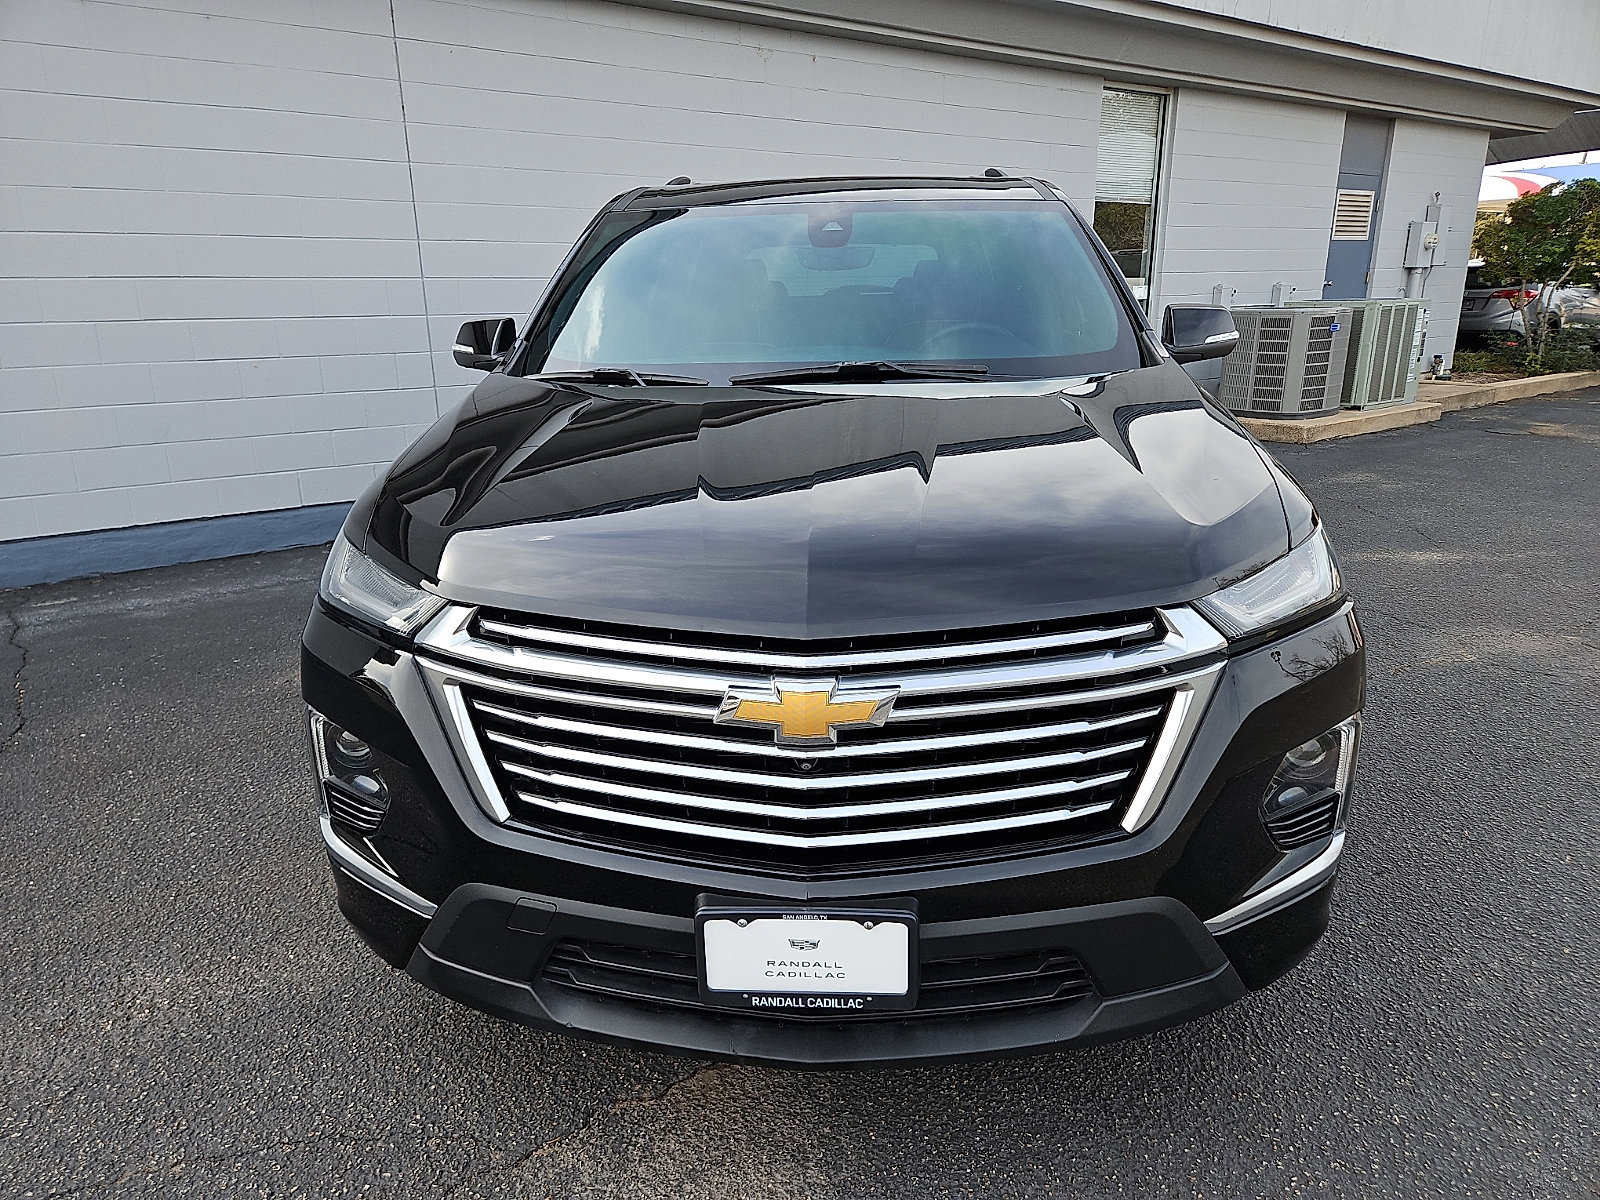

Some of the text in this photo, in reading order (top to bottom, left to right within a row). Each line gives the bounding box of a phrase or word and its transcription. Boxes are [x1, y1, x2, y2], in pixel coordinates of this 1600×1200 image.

[766, 960, 843, 968] RANDALL
[764, 970, 846, 978] CADILLAC
[752, 996, 864, 1009] RANDALL CADILLAC
